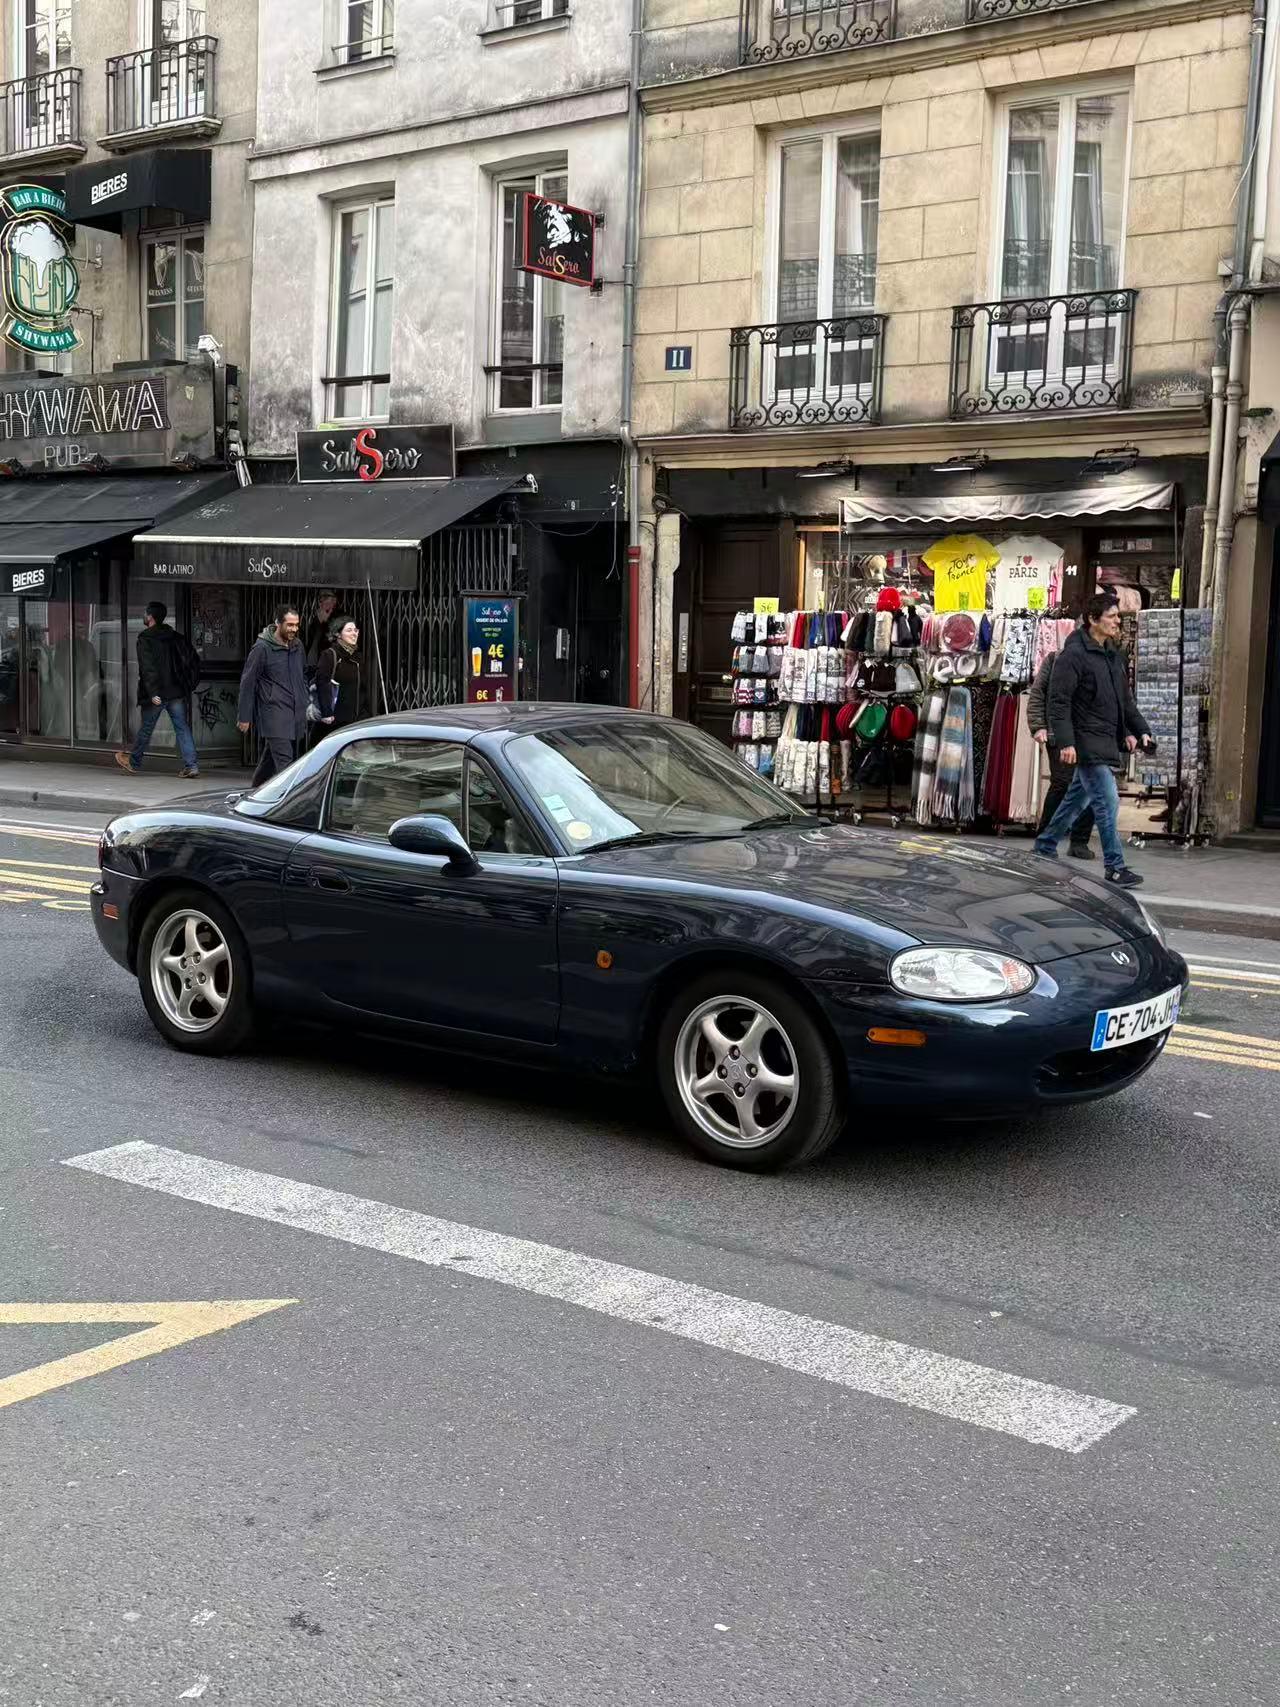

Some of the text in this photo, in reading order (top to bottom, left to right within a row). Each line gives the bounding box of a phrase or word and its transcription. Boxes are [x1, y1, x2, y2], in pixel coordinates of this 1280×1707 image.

[91, 172, 128, 203] BIERES
[13, 192, 32, 207] BAR
[672, 350, 685, 368] 11
[44, 444, 81, 467] PUB
[1016, 555, 1022, 567] I
[153, 563, 195, 576] BAR LATINO
[1009, 567, 1039, 579] PARIS
[12, 568, 45, 588] BIERES
[488, 643, 504, 658] 4€
[476, 689, 488, 700] 6€
